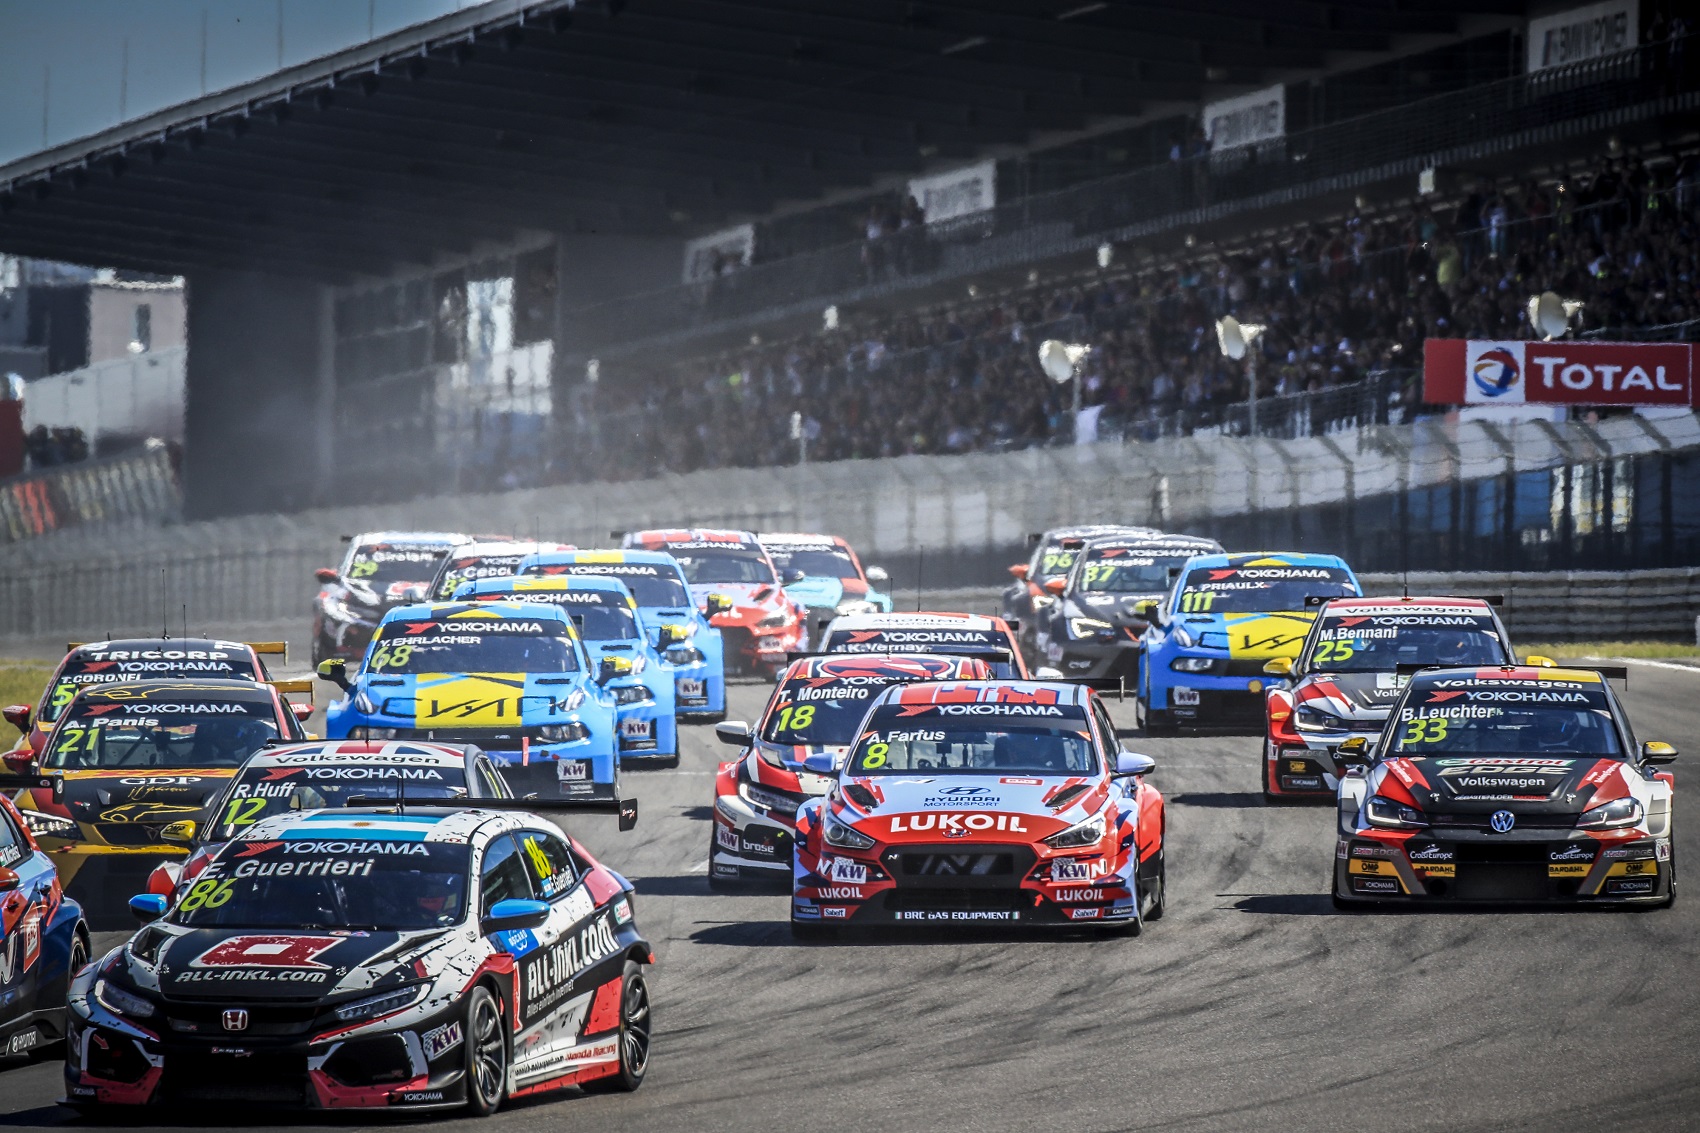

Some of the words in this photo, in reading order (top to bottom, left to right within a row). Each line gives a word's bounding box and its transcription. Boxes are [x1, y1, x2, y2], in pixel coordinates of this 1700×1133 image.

[1533, 356, 1683, 391] TOTAL
[568, 566, 658, 575] YOKOHAMA
[1237, 569, 1330, 579] YOKOHAMA
[1203, 581, 1266, 591] PRIAULX
[503, 593, 602, 603] YOKOHAMA
[1181, 592, 1214, 613] 111
[1345, 605, 1473, 614] Volkswagen
[1370, 616, 1478, 626] YOKOHAMA
[437, 622, 543, 633] YOKOHAMA
[881, 632, 988, 642] YOKOHAMA
[91, 651, 229, 661] TRICORP
[370, 644, 412, 668] 68
[1313, 640, 1354, 663] 25
[118, 662, 233, 671] YOKOHAMA
[1434, 679, 1582, 689] Volkswagen
[52, 684, 80, 707] 5
[797, 687, 868, 701] Monteiro
[1467, 691, 1589, 702] YOKOHAMA
[123, 704, 247, 714] YOKOHAMA
[938, 705, 1063, 716] YOKOHAMA
[92, 717, 159, 728] Panis
[778, 705, 815, 732] 18
[628, 723, 647, 734] KW
[1402, 718, 1448, 743] 33
[57, 728, 100, 752] 21
[275, 754, 440, 764] Volkswagen
[863, 743, 889, 769] 8
[304, 767, 443, 780] YOKOHAMA
[563, 765, 584, 776] KW
[1437, 766, 1573, 776] EDGE
[119, 777, 202, 785] GDP
[1458, 777, 1545, 787] Volkswagen
[223, 798, 267, 825] 12
[890, 814, 1028, 833] LUKOIL
[283, 842, 430, 856] YOKOHAMA
[743, 839, 774, 853] brose
[201, 863, 226, 879] E.
[233, 858, 376, 878] Guerrieri
[837, 865, 864, 879] KW
[1059, 864, 1088, 878] KW
[1361, 862, 1379, 872] OMP
[1625, 864, 1644, 873] OMP
[179, 878, 236, 912] 86
[818, 887, 863, 898] LUKOIL
[1056, 889, 1104, 901] LUKOIL
[905, 911, 925, 919] BRC
[952, 911, 1010, 919] EQUIPMENT
[432, 1031, 461, 1056] KW
[404, 1092, 443, 1101] YOKOHAMA
